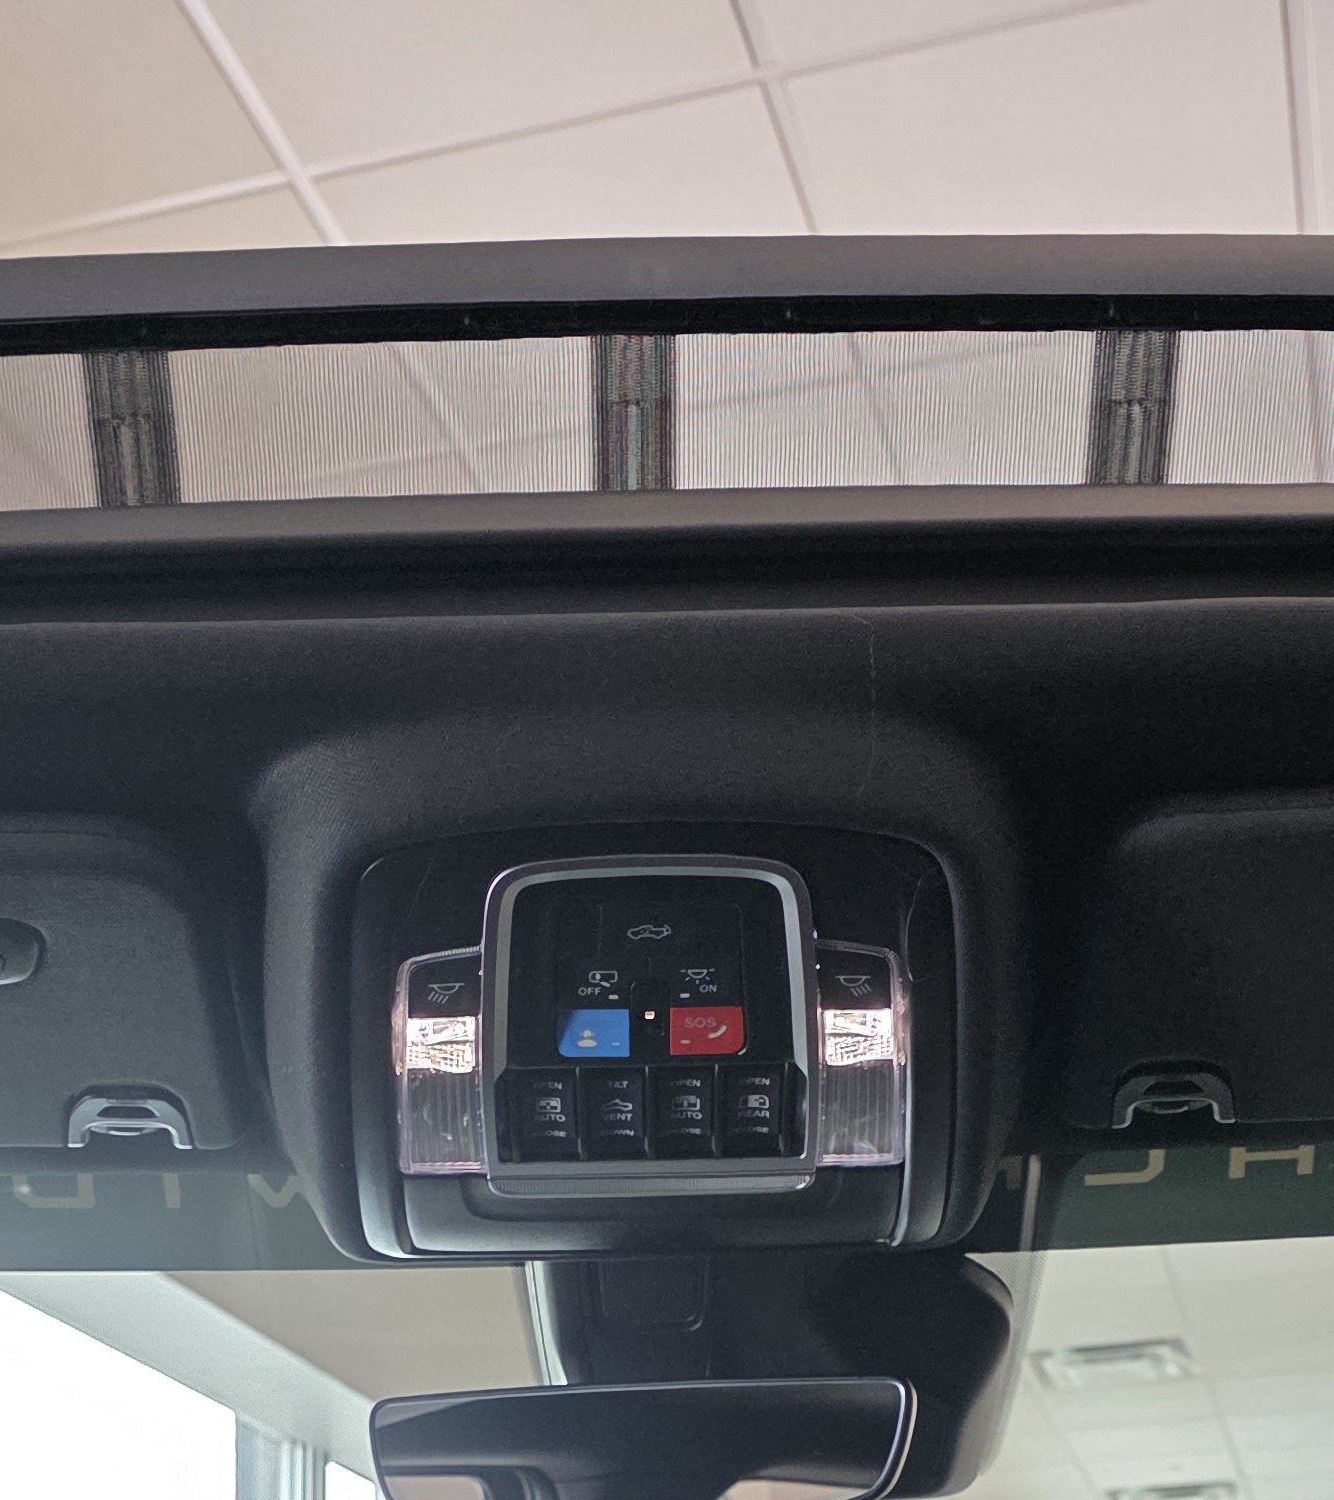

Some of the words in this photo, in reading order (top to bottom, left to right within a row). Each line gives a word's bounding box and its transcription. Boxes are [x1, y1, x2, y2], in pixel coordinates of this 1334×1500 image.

[578, 987, 602, 996] OFF
[699, 984, 717, 993] ON
[684, 1017, 716, 1028] SOS
[603, 1113, 634, 1122] VENT
